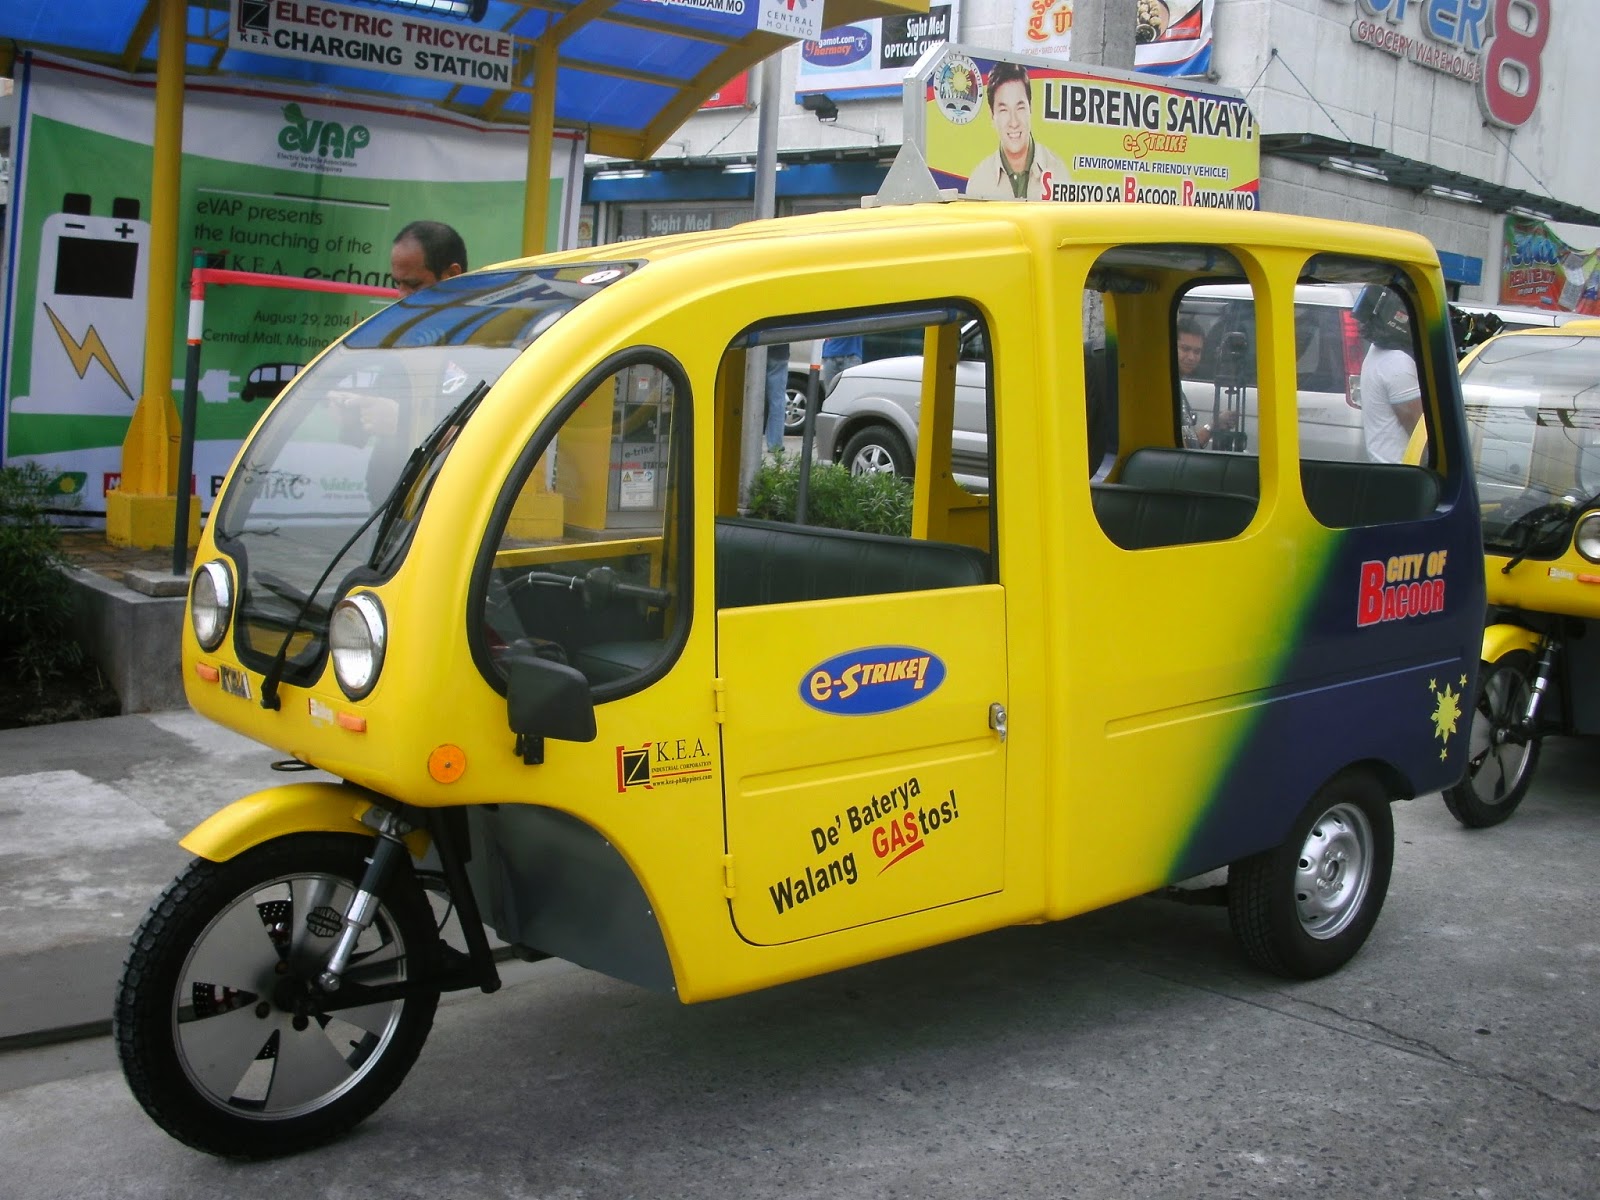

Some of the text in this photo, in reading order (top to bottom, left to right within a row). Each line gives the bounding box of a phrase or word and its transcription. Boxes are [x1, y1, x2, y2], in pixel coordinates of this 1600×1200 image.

[275, 1, 511, 58] ELECTRIC TRICYCLE
[766, 20, 813, 36] MOLINO
[767, 10, 813, 27] CENTRAL
[906, 14, 946, 41] Sight Med
[805, 41, 852, 57] Pharmacy
[819, 36, 855, 48] gamot.com
[884, 43, 918, 58] OPTICAL
[1357, 20, 1481, 82] GROCERY WAREHOUSE
[273, 29, 509, 83] CHARGING STATION
[1484, 0, 1552, 126] 8
[1044, 83, 1254, 140] LIBRENG SAKAY!
[1151, 163, 1193, 177] FRIENDLY
[1193, 165, 1229, 181] VEHICLE)
[1041, 171, 1104, 203] SERBISYO
[1106, 186, 1121, 203] SA
[1182, 180, 1235, 211] RAMDAM
[1235, 193, 1254, 211] MO
[197, 198, 323, 226] eVAP presents
[651, 214, 681, 234] Sight
[684, 213, 712, 232] Med
[194, 224, 373, 255] the launching of the
[253, 311, 297, 325] August
[323, 314, 350, 328] 2014
[202, 328, 249, 344] Central
[286, 335, 330, 349] Molino
[1386, 549, 1448, 584] CITY OF
[1357, 560, 1445, 628] BACOOR
[656, 738, 710, 762] K.E.A.
[651, 761, 712, 773] INDUSTRIAL CORPORATION
[846, 777, 921, 834] Baterya
[768, 789, 960, 915] Walang GAStos!
